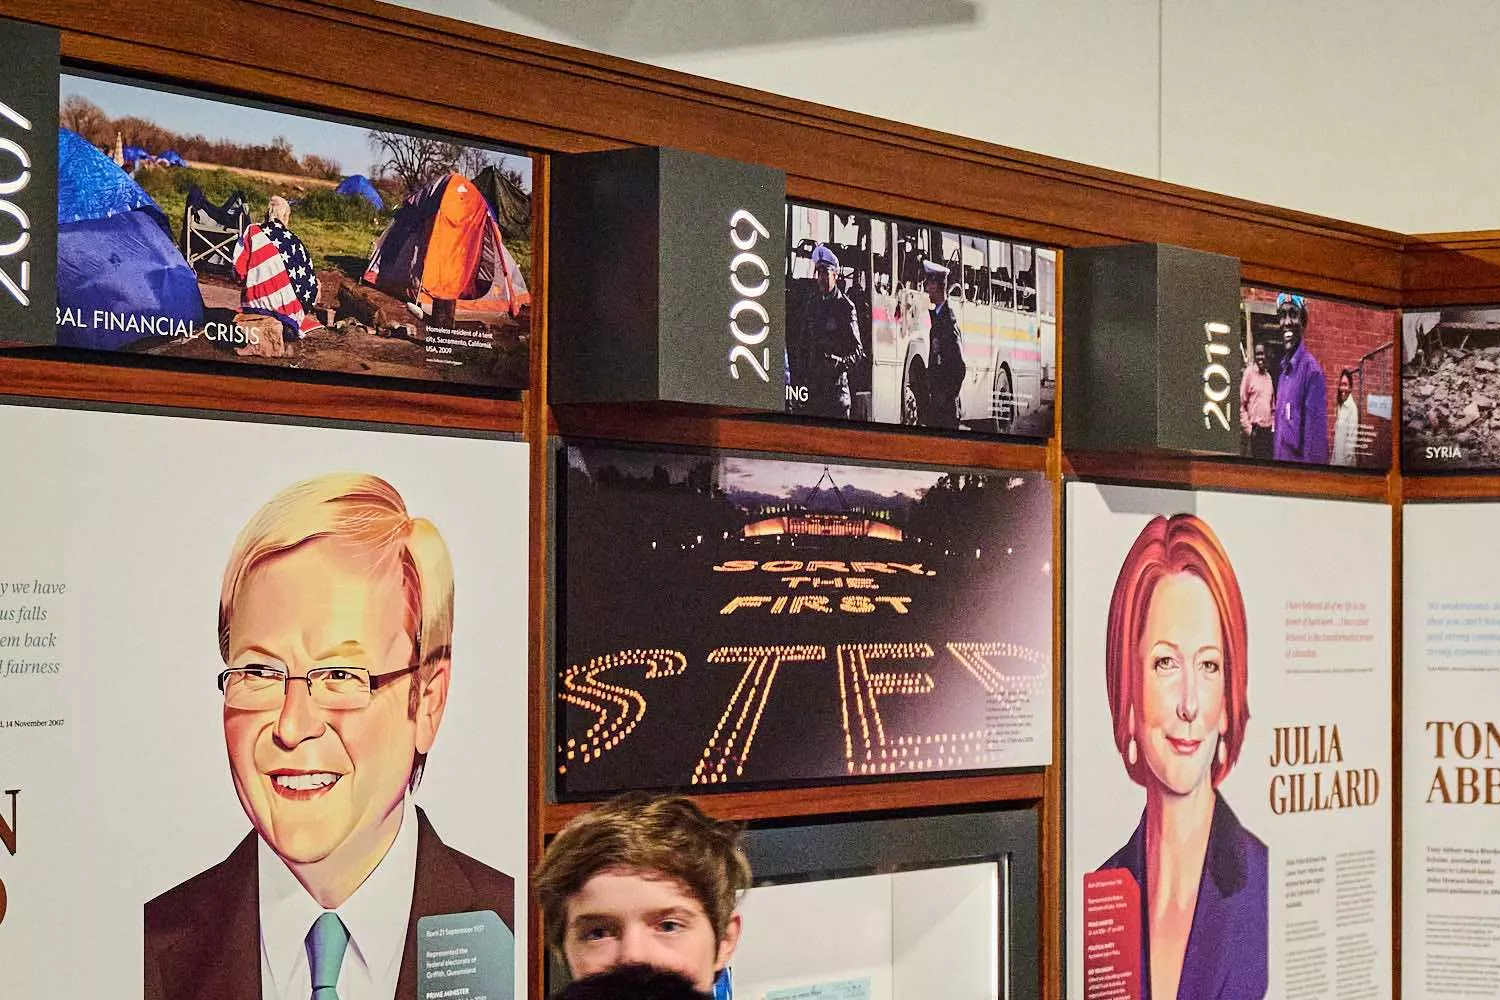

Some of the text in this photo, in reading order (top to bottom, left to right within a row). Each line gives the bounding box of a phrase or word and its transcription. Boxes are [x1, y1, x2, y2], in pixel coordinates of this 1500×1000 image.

[730, 208, 770, 383] 2009
[93, 310, 199, 339] FINANCIAL
[203, 322, 260, 345] CRISIS
[1203, 322, 1231, 432] 2011
[1426, 446, 1462, 460] SYRIA
[12, 582, 30, 595] we
[33, 579, 66, 595] have
[782, 576, 879, 589] THE
[720, 595, 912, 614] FIRST
[15, 605, 48, 624] falls
[24, 632, 57, 648] back
[4, 659, 61, 678] fairness
[1269, 724, 1344, 768] JULIA
[1269, 767, 1380, 816] GILLARD
